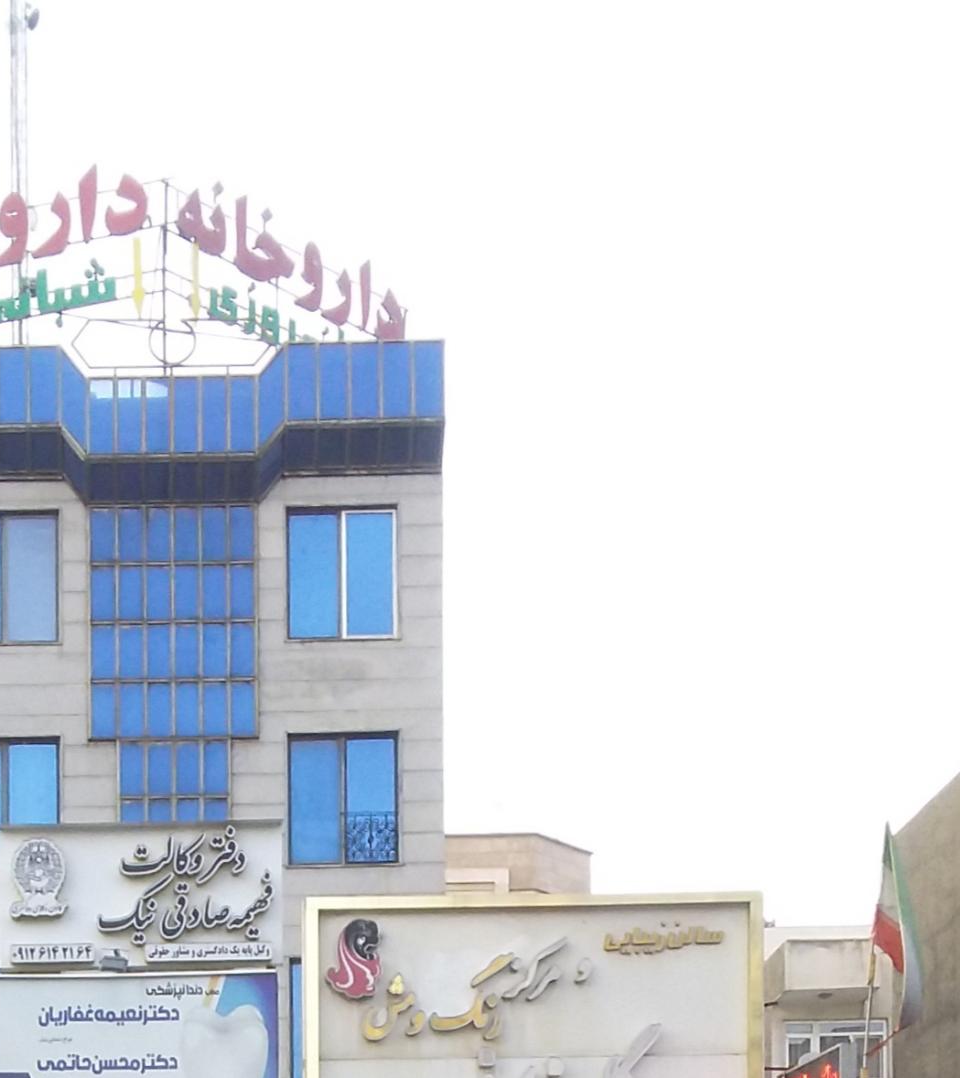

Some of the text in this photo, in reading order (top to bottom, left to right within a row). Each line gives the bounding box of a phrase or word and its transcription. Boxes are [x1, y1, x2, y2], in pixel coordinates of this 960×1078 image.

[175, 181, 407, 340] داروخانه
[121, 825, 246, 885] دفتر وکالت
[160, 882, 230, 940] صادقی
[667, 921, 725, 950] سالن
[146, 981, 203, 1001] دندانپزشکی
[94, 1005, 143, 1026] نعیمه
[142, 1004, 180, 1026] دکتر
[37, 1053, 178, 1075] دکتر محسن حاتمی
